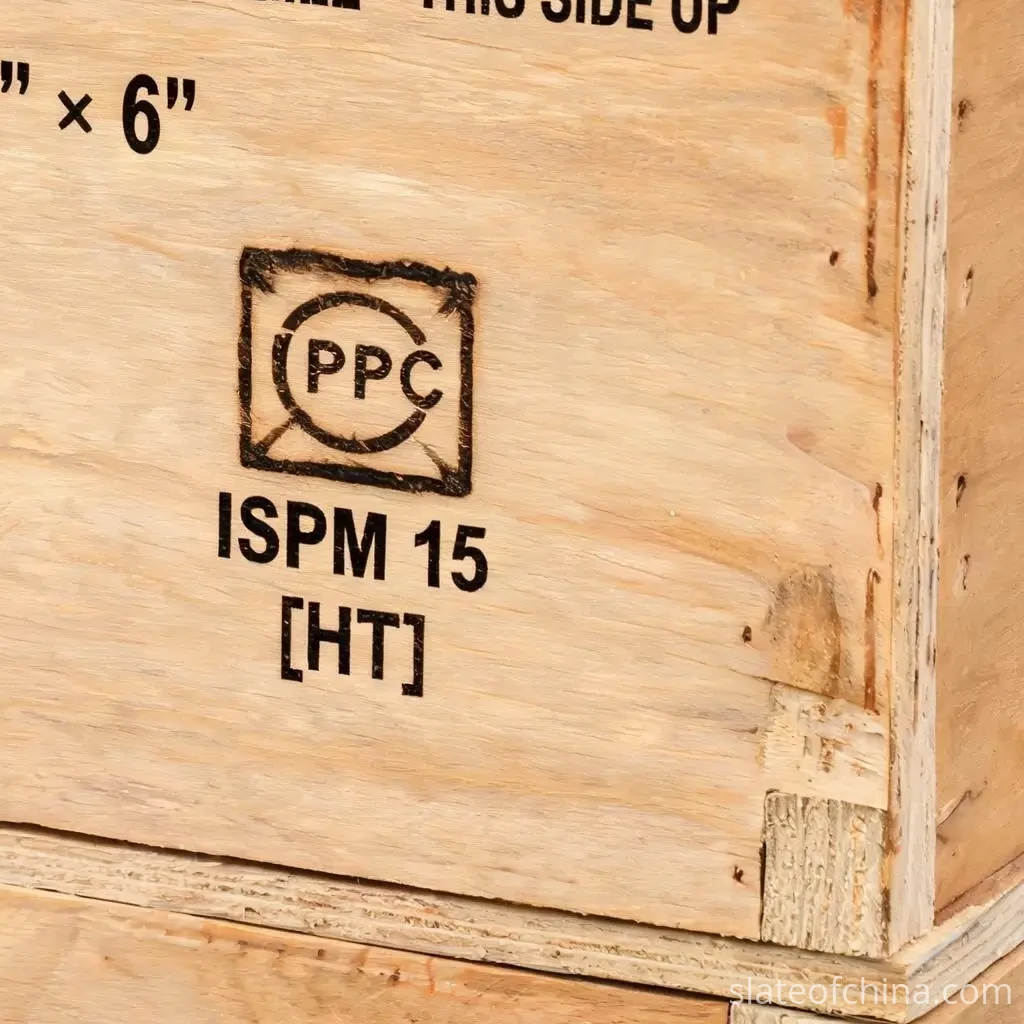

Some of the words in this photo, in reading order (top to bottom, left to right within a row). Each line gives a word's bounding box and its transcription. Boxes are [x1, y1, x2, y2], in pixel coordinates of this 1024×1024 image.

[307, 338, 445, 411] PPC
[218, 491, 387, 581] ISPM
[414, 520, 489, 593] 15
[280, 595, 425, 698] [HT]
